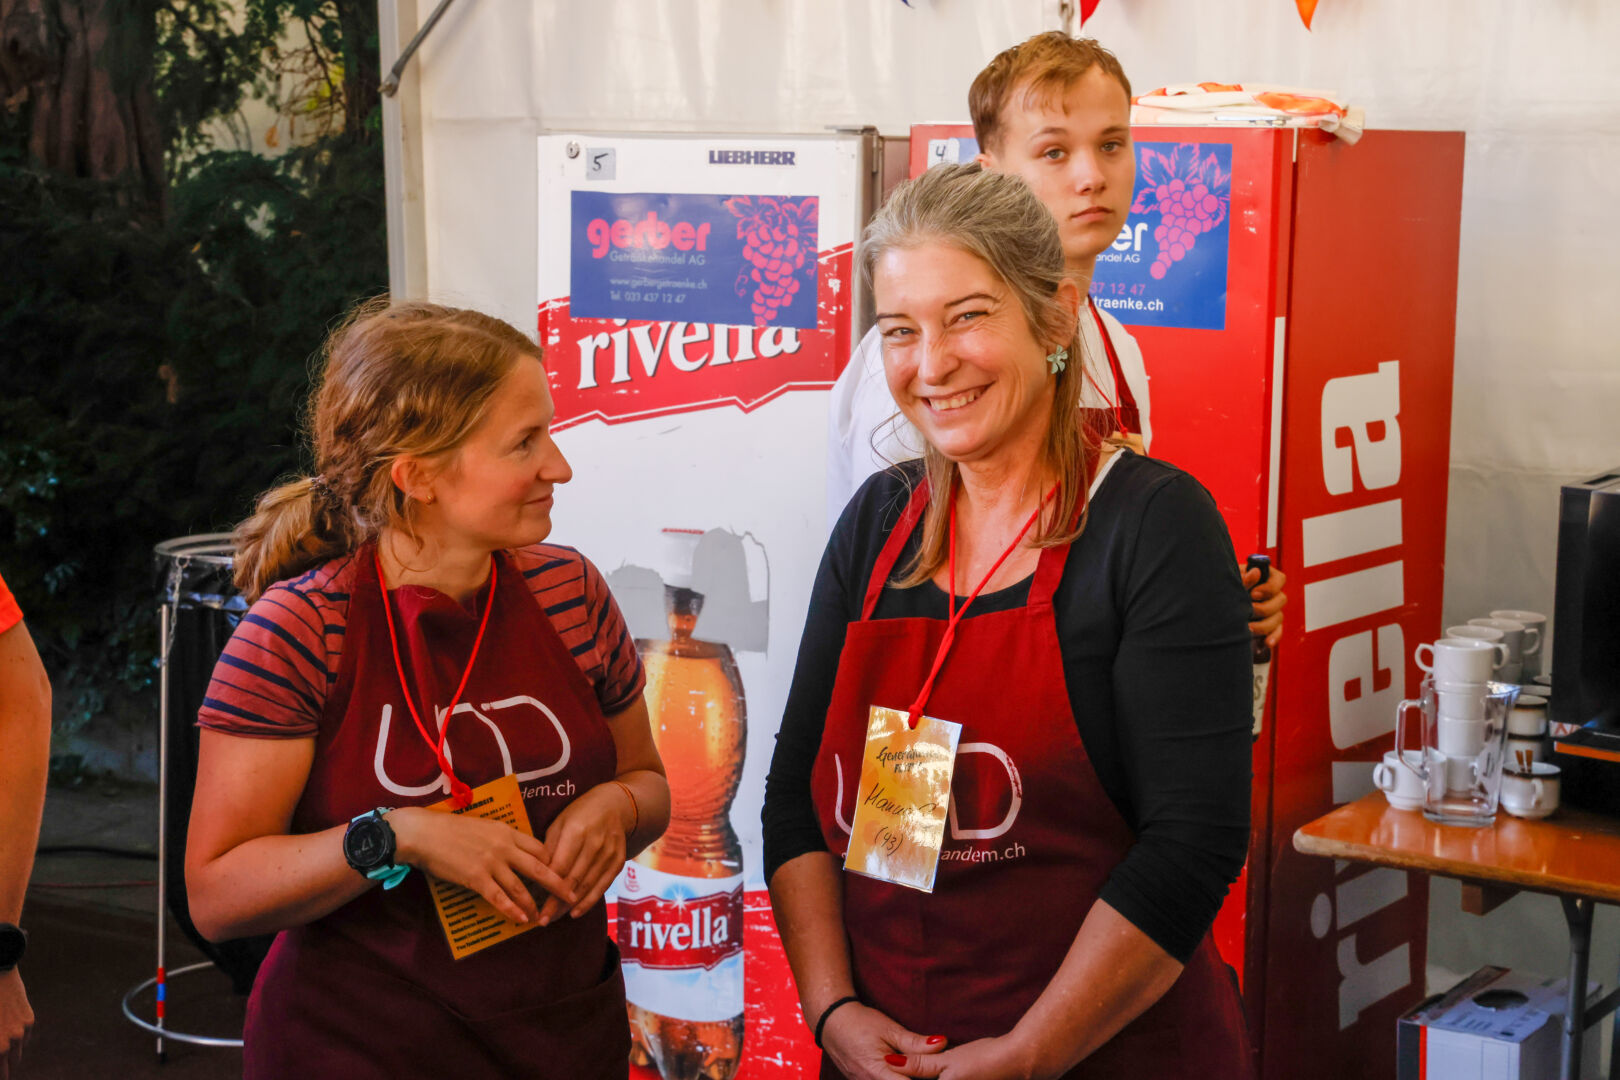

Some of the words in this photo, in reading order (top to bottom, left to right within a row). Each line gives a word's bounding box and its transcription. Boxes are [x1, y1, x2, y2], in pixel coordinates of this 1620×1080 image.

[709, 150, 796, 165] LIEBHERR
[935, 145, 947, 161] 4
[592, 153, 609, 172] 5
[587, 211, 711, 259] gerber
[1111, 222, 1148, 252] er
[688, 254, 706, 266] AG
[1095, 253, 1122, 263] andel
[1123, 254, 1141, 263] AG
[1110, 282, 1126, 296] 12
[1130, 283, 1146, 296] 47
[662, 292, 672, 303] 12
[674, 293, 686, 304] 47
[1093, 295, 1164, 311] traenke.ch
[940, 842, 1026, 863] andem.ch
[630, 907, 729, 951] rivella
